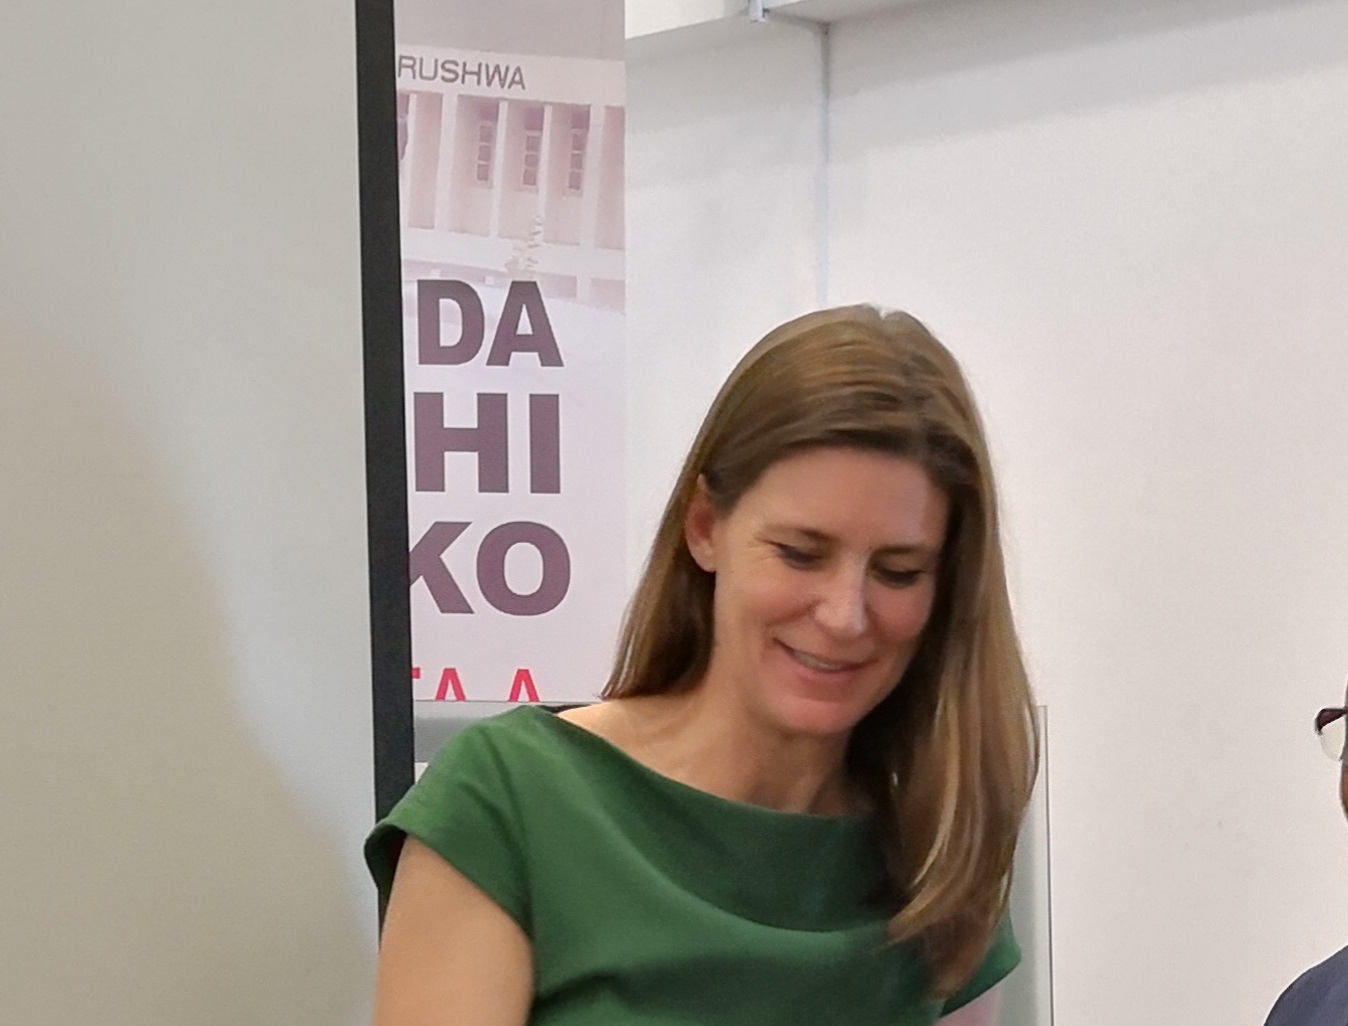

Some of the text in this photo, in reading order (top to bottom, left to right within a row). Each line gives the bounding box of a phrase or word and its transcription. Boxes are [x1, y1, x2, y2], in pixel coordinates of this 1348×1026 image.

[397, 55, 526, 91] RUSHWA
[416, 279, 564, 368] DA
[413, 391, 561, 494] HI
[409, 520, 571, 617] KO
